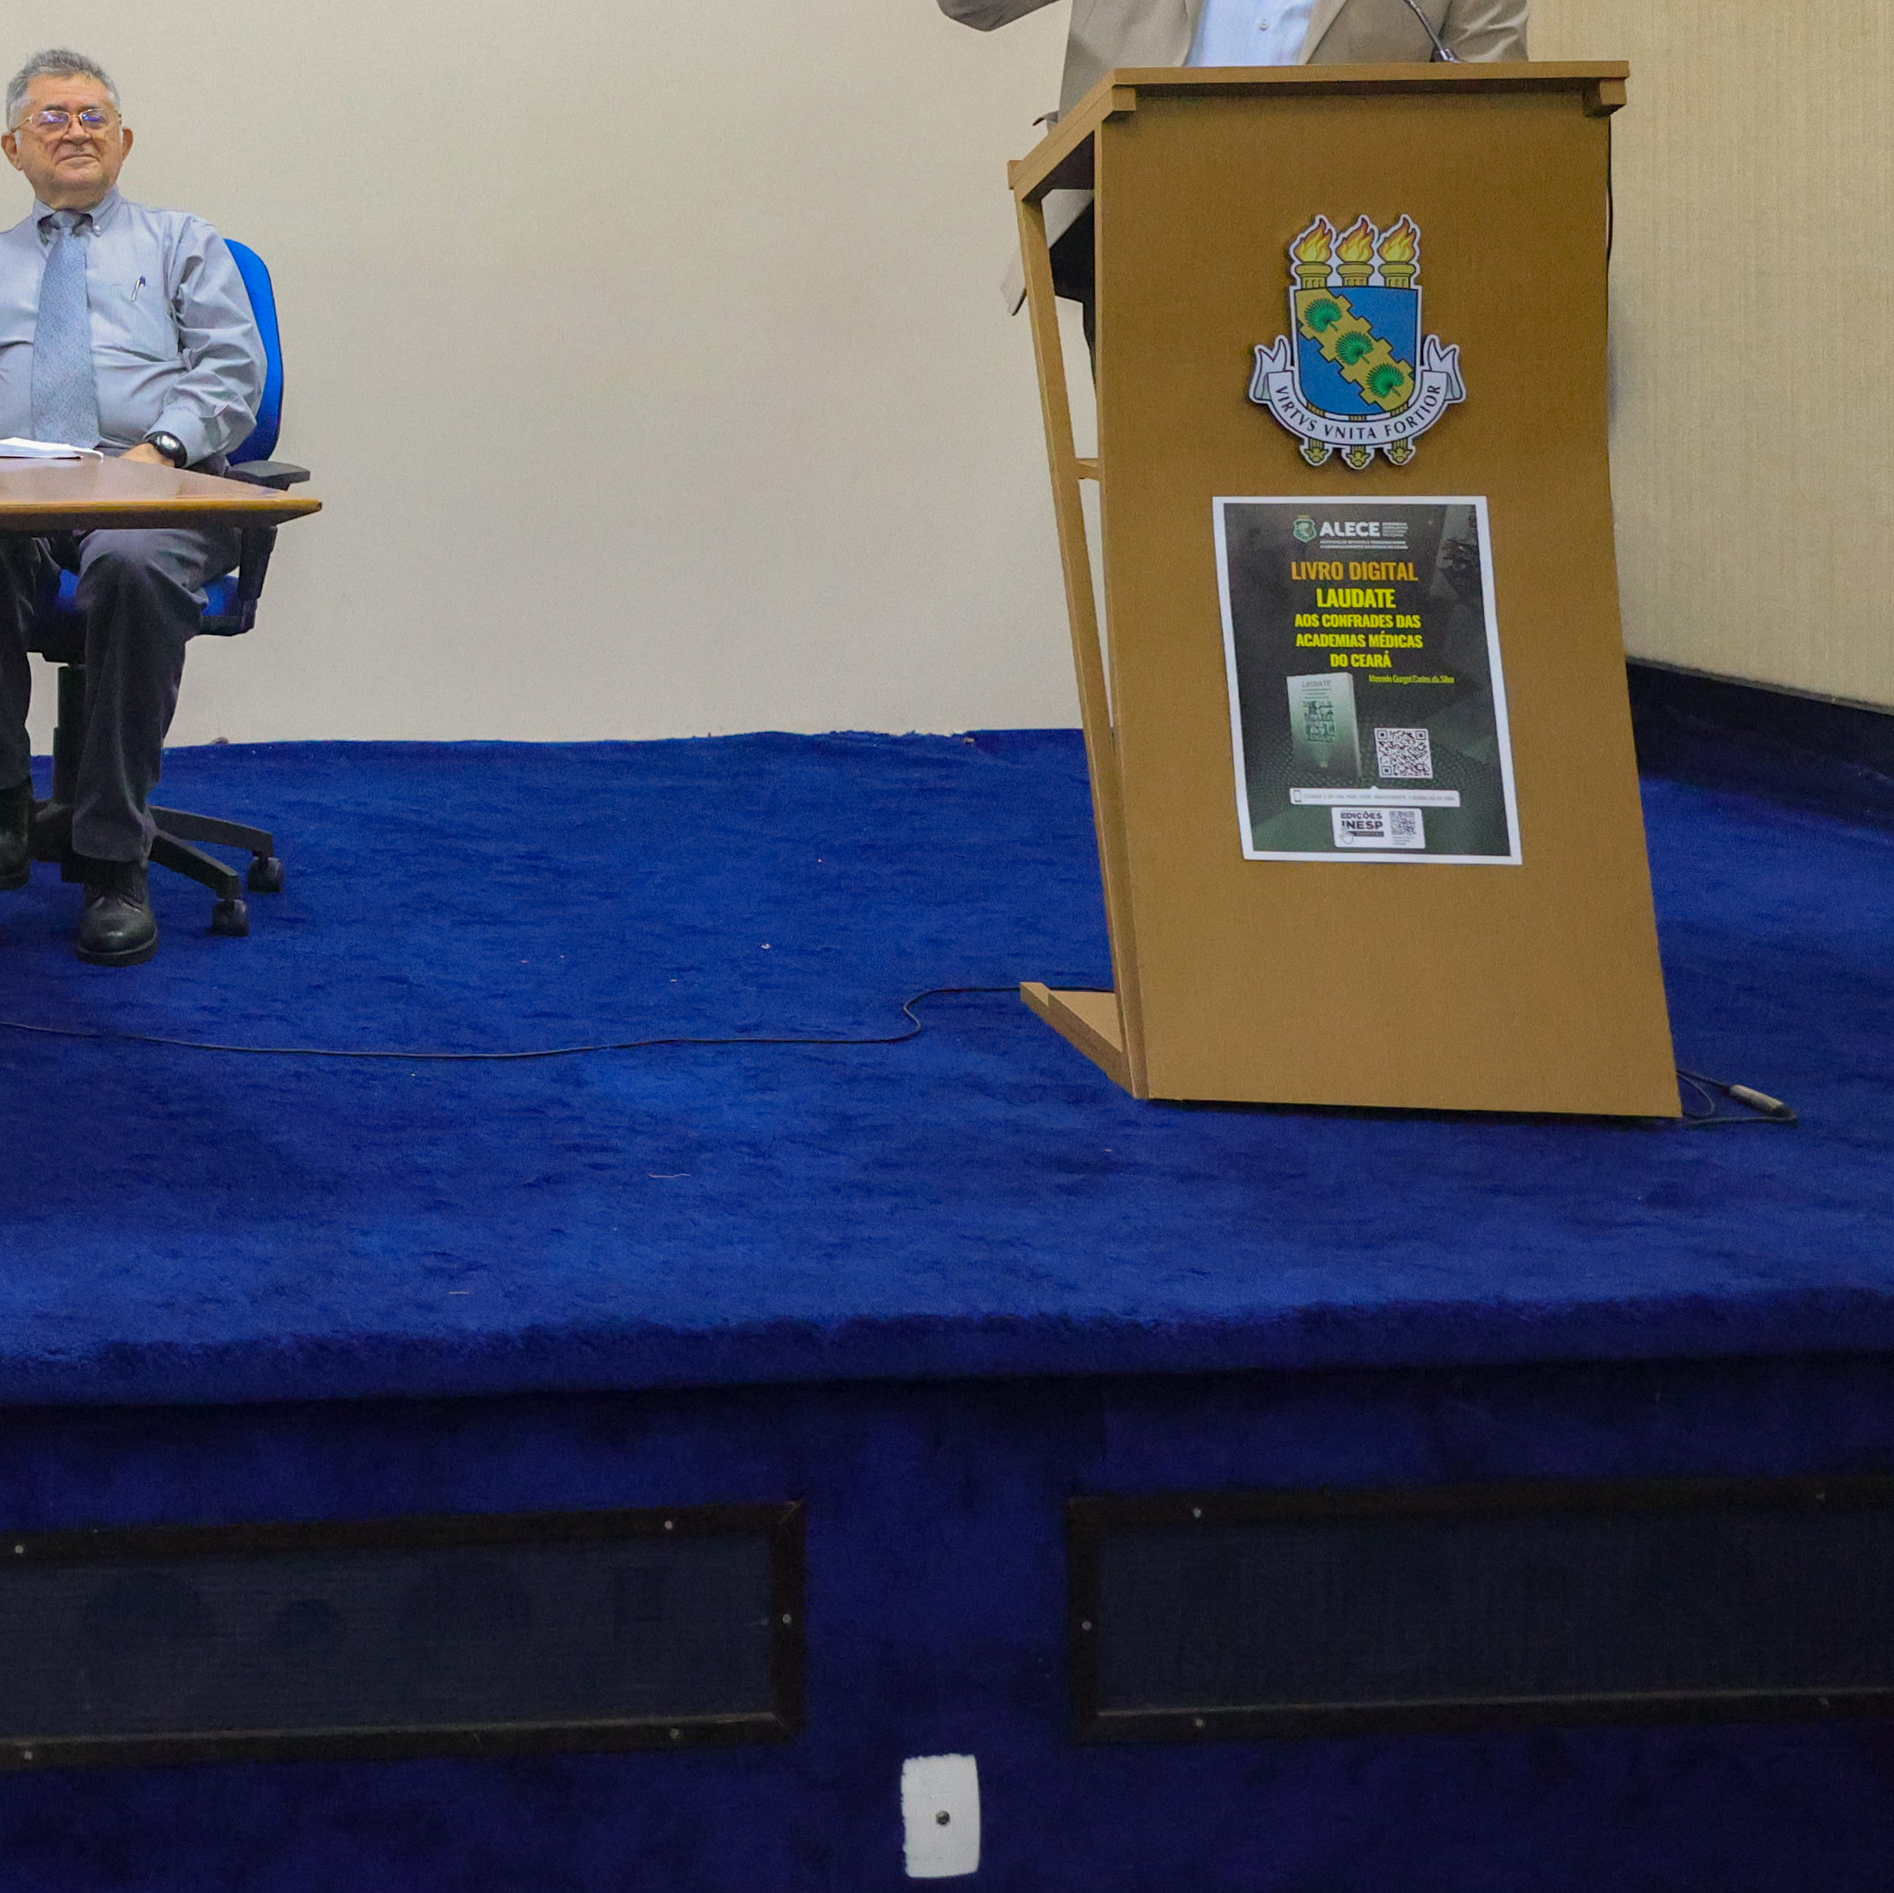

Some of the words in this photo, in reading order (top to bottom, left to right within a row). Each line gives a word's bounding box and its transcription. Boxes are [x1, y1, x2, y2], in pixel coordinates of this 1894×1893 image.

[1275, 385, 1318, 432] VIRTVS
[1324, 424, 1377, 440] VNITA
[1384, 384, 1442, 437] FORTIOR
[1319, 521, 1381, 537] ALECE
[1291, 561, 1344, 581] LIVRO
[1348, 561, 1419, 581] DIGITAL
[1315, 588, 1397, 608] LAUDATE
[1294, 613, 1320, 628] AOS
[1321, 613, 1394, 629] CONFRADES
[1395, 614, 1422, 629] DAS
[1295, 633, 1367, 648] ACADEMIAS
[1368, 630, 1424, 649] MÉDICAS
[1329, 653, 1349, 668] DO
[1350, 649, 1393, 668] CEARÁ
[1340, 811, 1383, 820] EDIÇÕES
[1341, 820, 1384, 830] INESP
